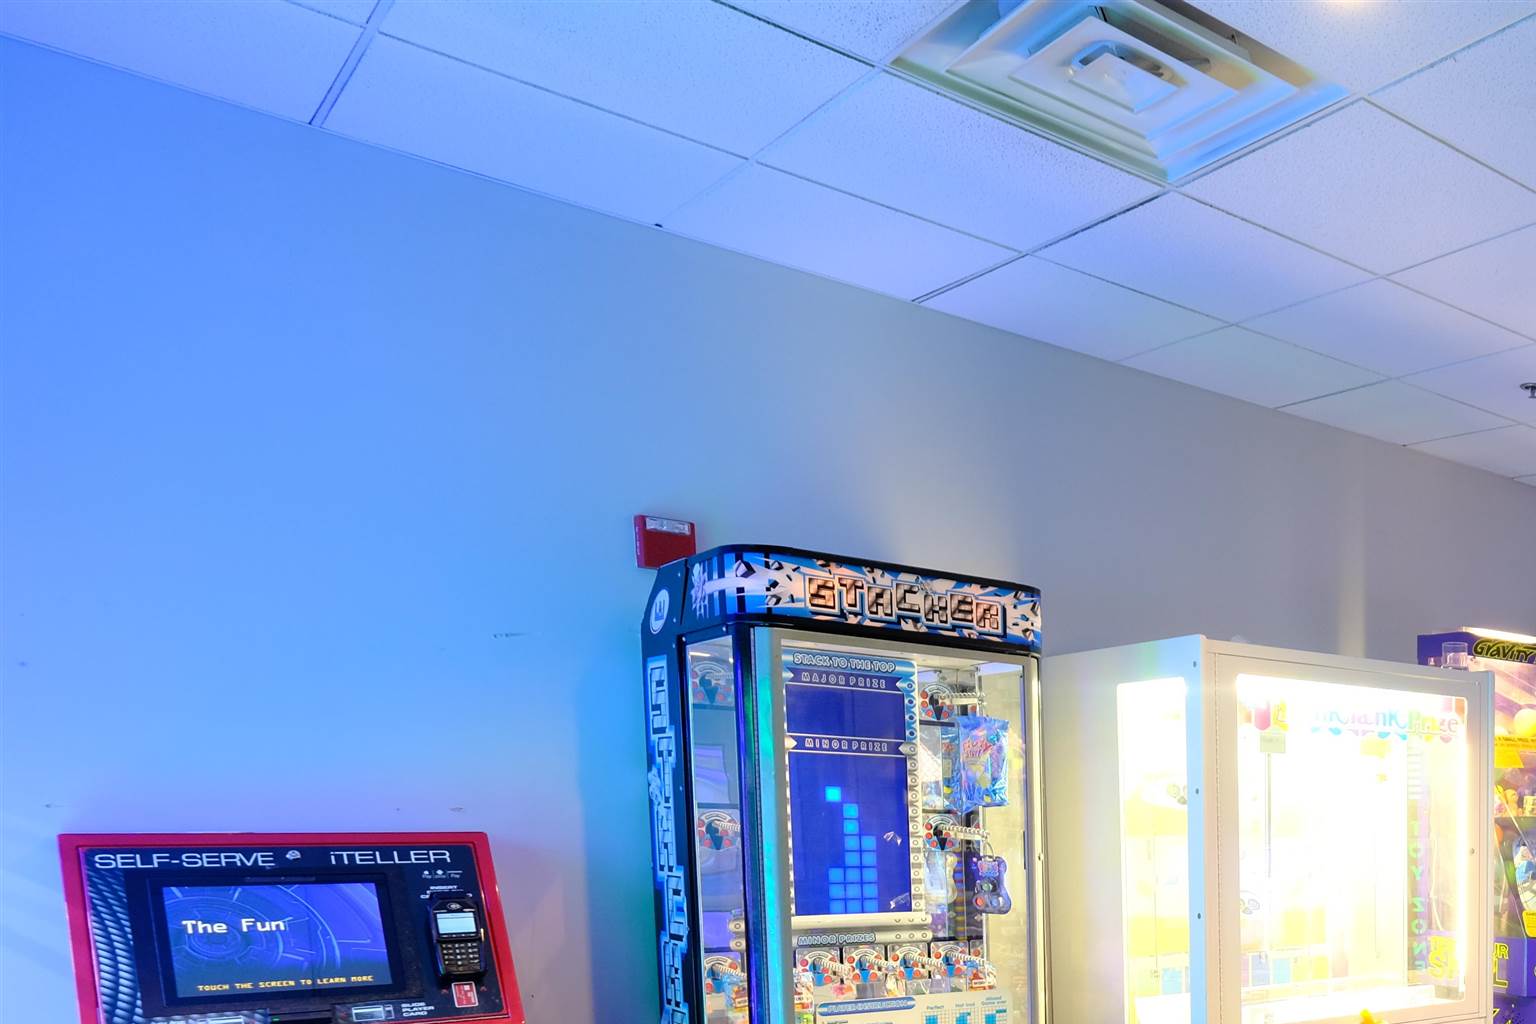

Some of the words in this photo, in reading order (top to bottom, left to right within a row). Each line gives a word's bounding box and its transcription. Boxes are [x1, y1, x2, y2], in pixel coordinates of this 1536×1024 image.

[808, 577, 1000, 630] STACKER
[793, 653, 830, 667] STACK
[832, 656, 848, 668] TO
[850, 658, 871, 671] THE
[873, 661, 896, 673] TOP
[801, 672, 845, 685] MAJOR
[849, 676, 886, 688] PRIZE
[805, 738, 848, 750] MINOR
[852, 741, 887, 752] PRIZE
[94, 851, 275, 870] SELF-SERVE
[331, 849, 452, 866] iTELLER
[182, 919, 228, 935] The
[241, 917, 286, 932] Fun
[798, 934, 837, 945] MINOR
[839, 932, 875, 944] PRIZES
[197, 984, 231, 992] TOUCH
[235, 982, 253, 990] THE
[259, 980, 295, 988] SCREEN
[317, 976, 346, 984] LEARN
[351, 975, 374, 983] MORE
